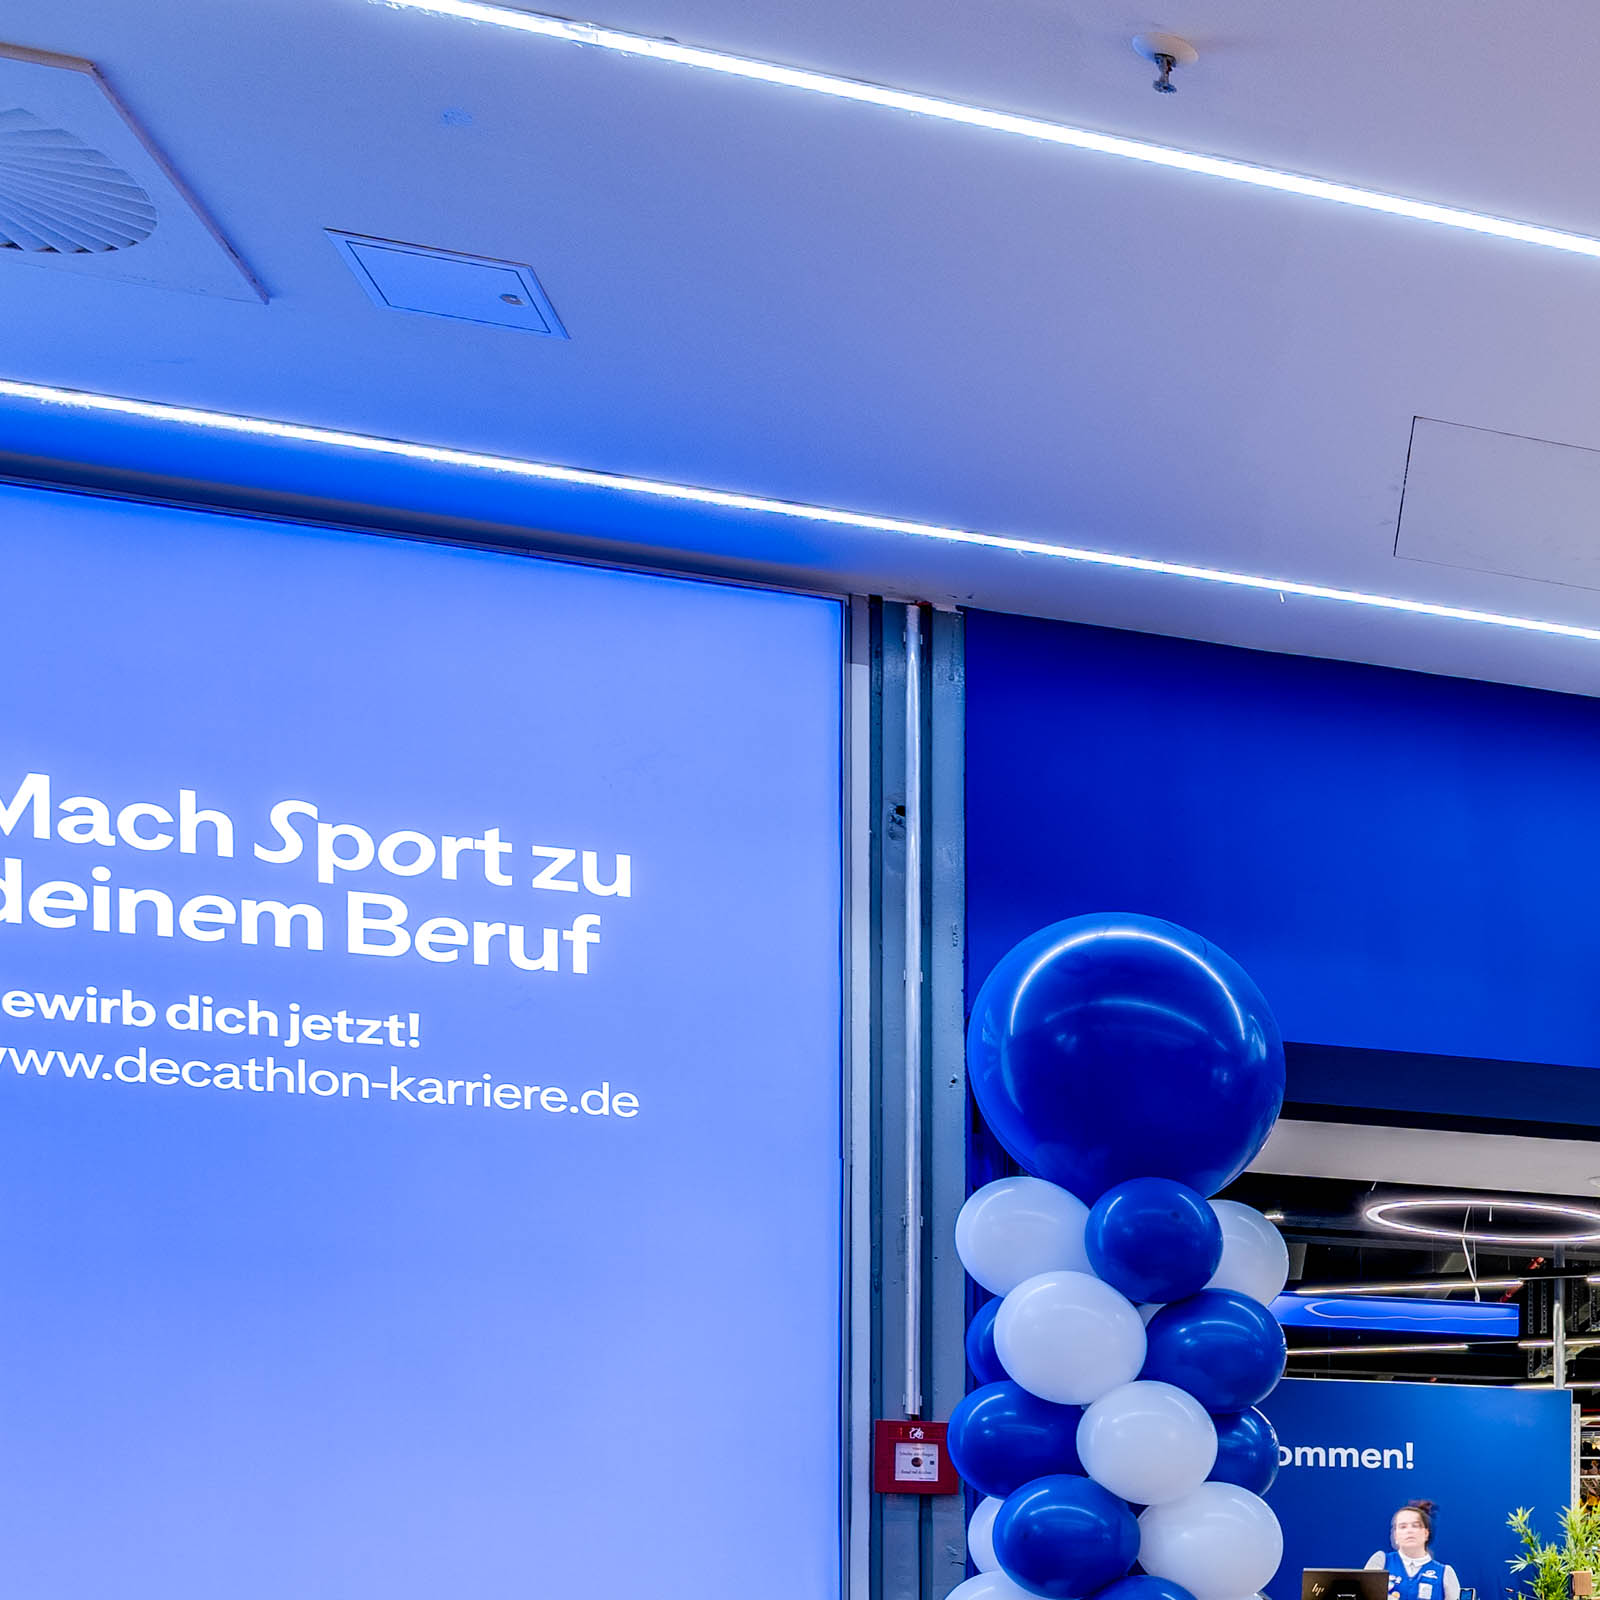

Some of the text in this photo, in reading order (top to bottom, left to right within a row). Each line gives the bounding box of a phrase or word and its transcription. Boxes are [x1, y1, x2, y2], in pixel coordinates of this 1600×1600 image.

[0, 772, 632, 898] Mach Sport zu
[347, 890, 601, 974] Beruf
[165, 994, 279, 1037] dich
[284, 1002, 421, 1049] jetzt!
[0, 1046, 640, 1118] ww.decathlon-karriere.de
